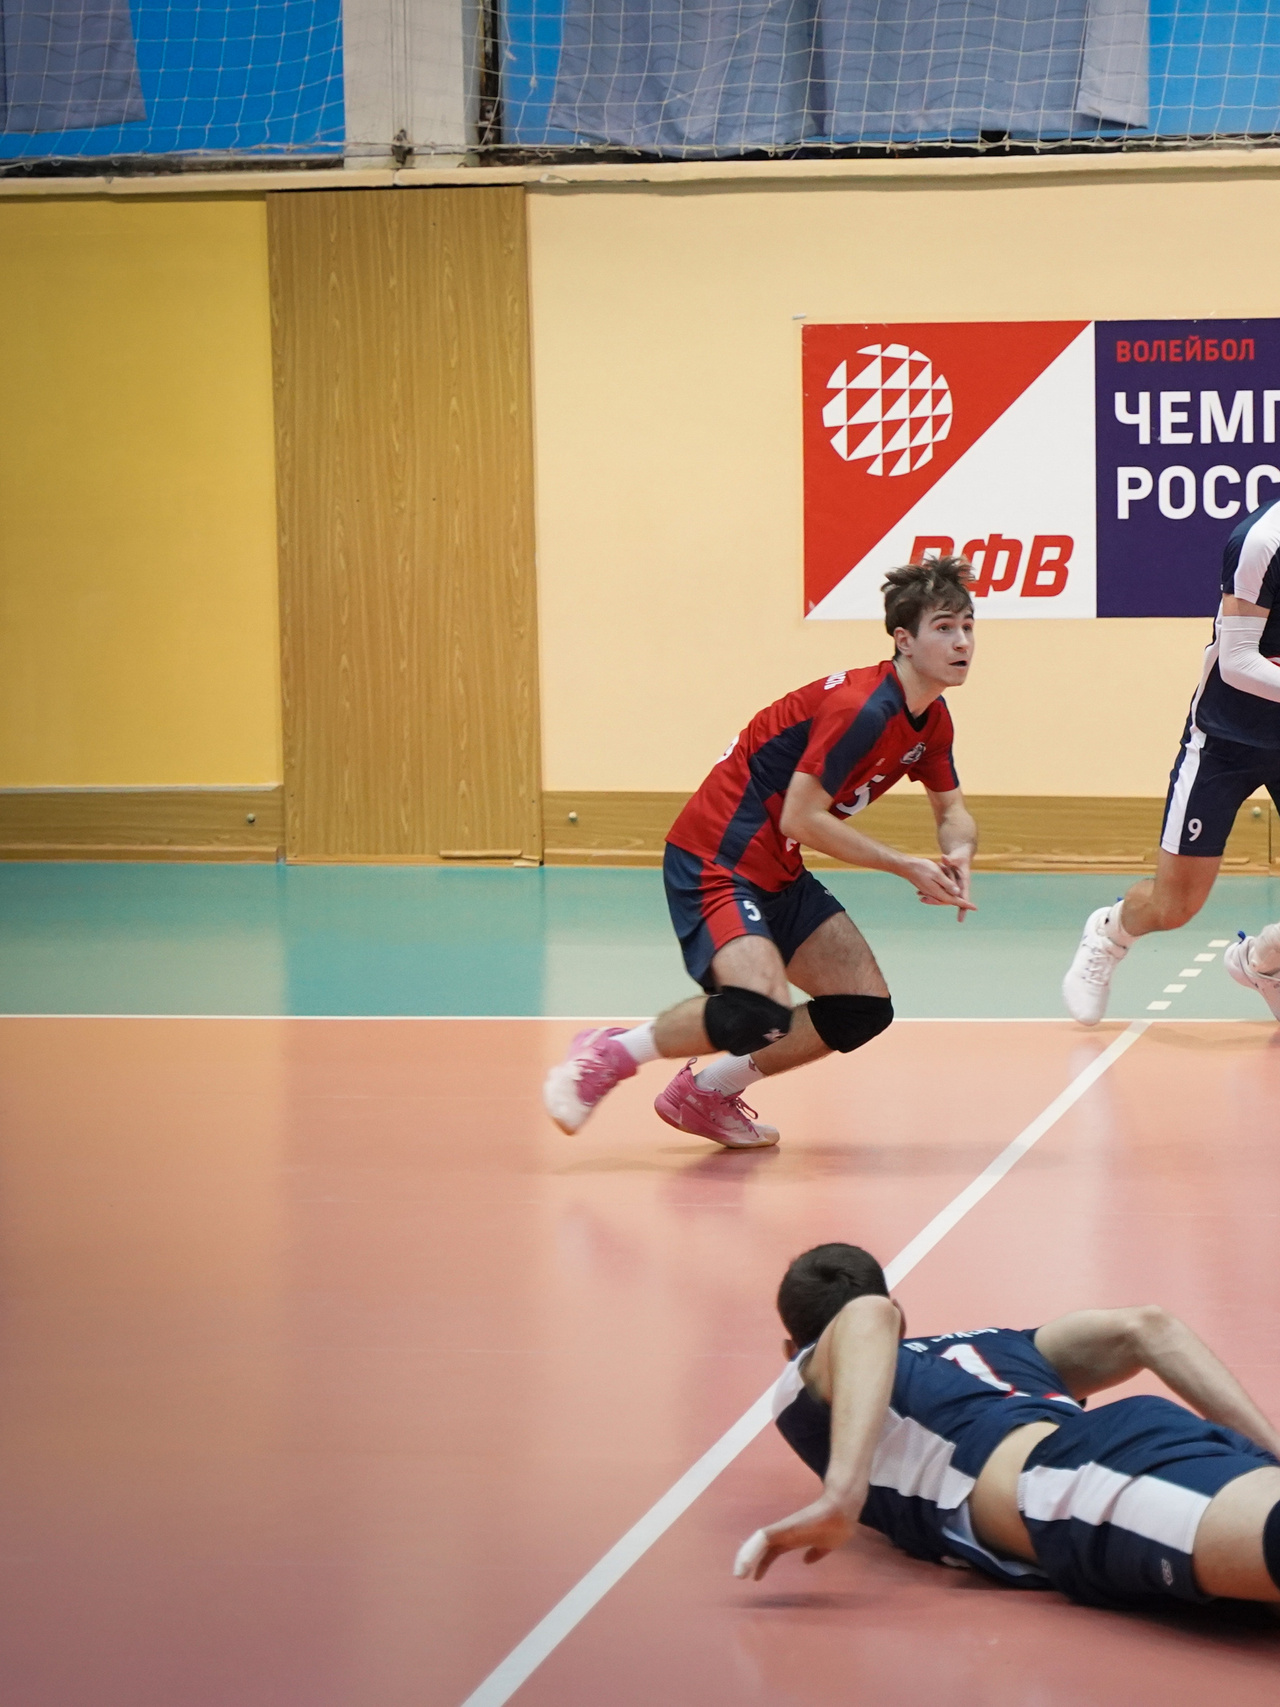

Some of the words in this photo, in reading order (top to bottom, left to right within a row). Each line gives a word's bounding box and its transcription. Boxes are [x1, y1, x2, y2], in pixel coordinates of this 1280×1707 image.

[1116, 335, 1256, 363] ВОЛЕЙБОЛ
[1187, 817, 1203, 842] 9
[742, 900, 761, 922] 5
